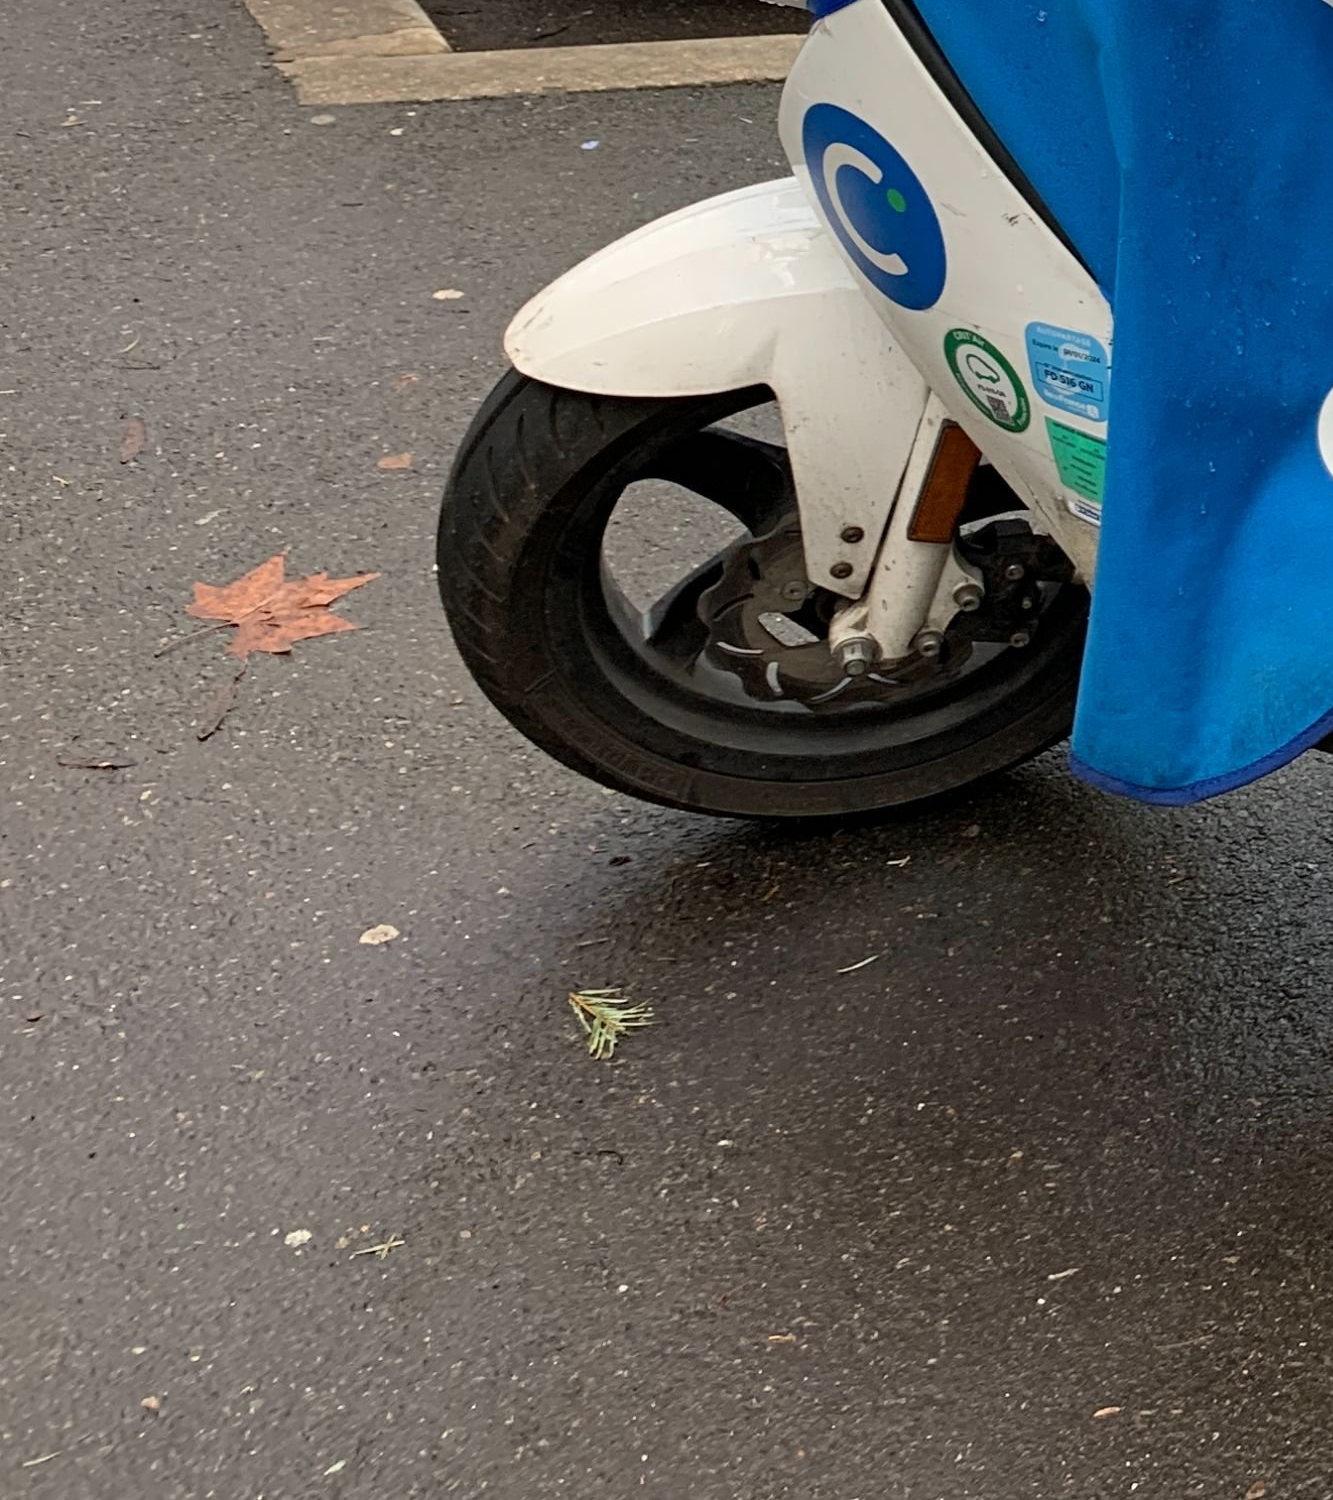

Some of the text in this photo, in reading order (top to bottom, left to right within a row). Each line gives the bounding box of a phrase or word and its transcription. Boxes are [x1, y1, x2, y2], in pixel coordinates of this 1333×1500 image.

[1043, 369, 1059, 381] FD
[1059, 373, 1077, 388] 516
[1078, 380, 1094, 393] GN
